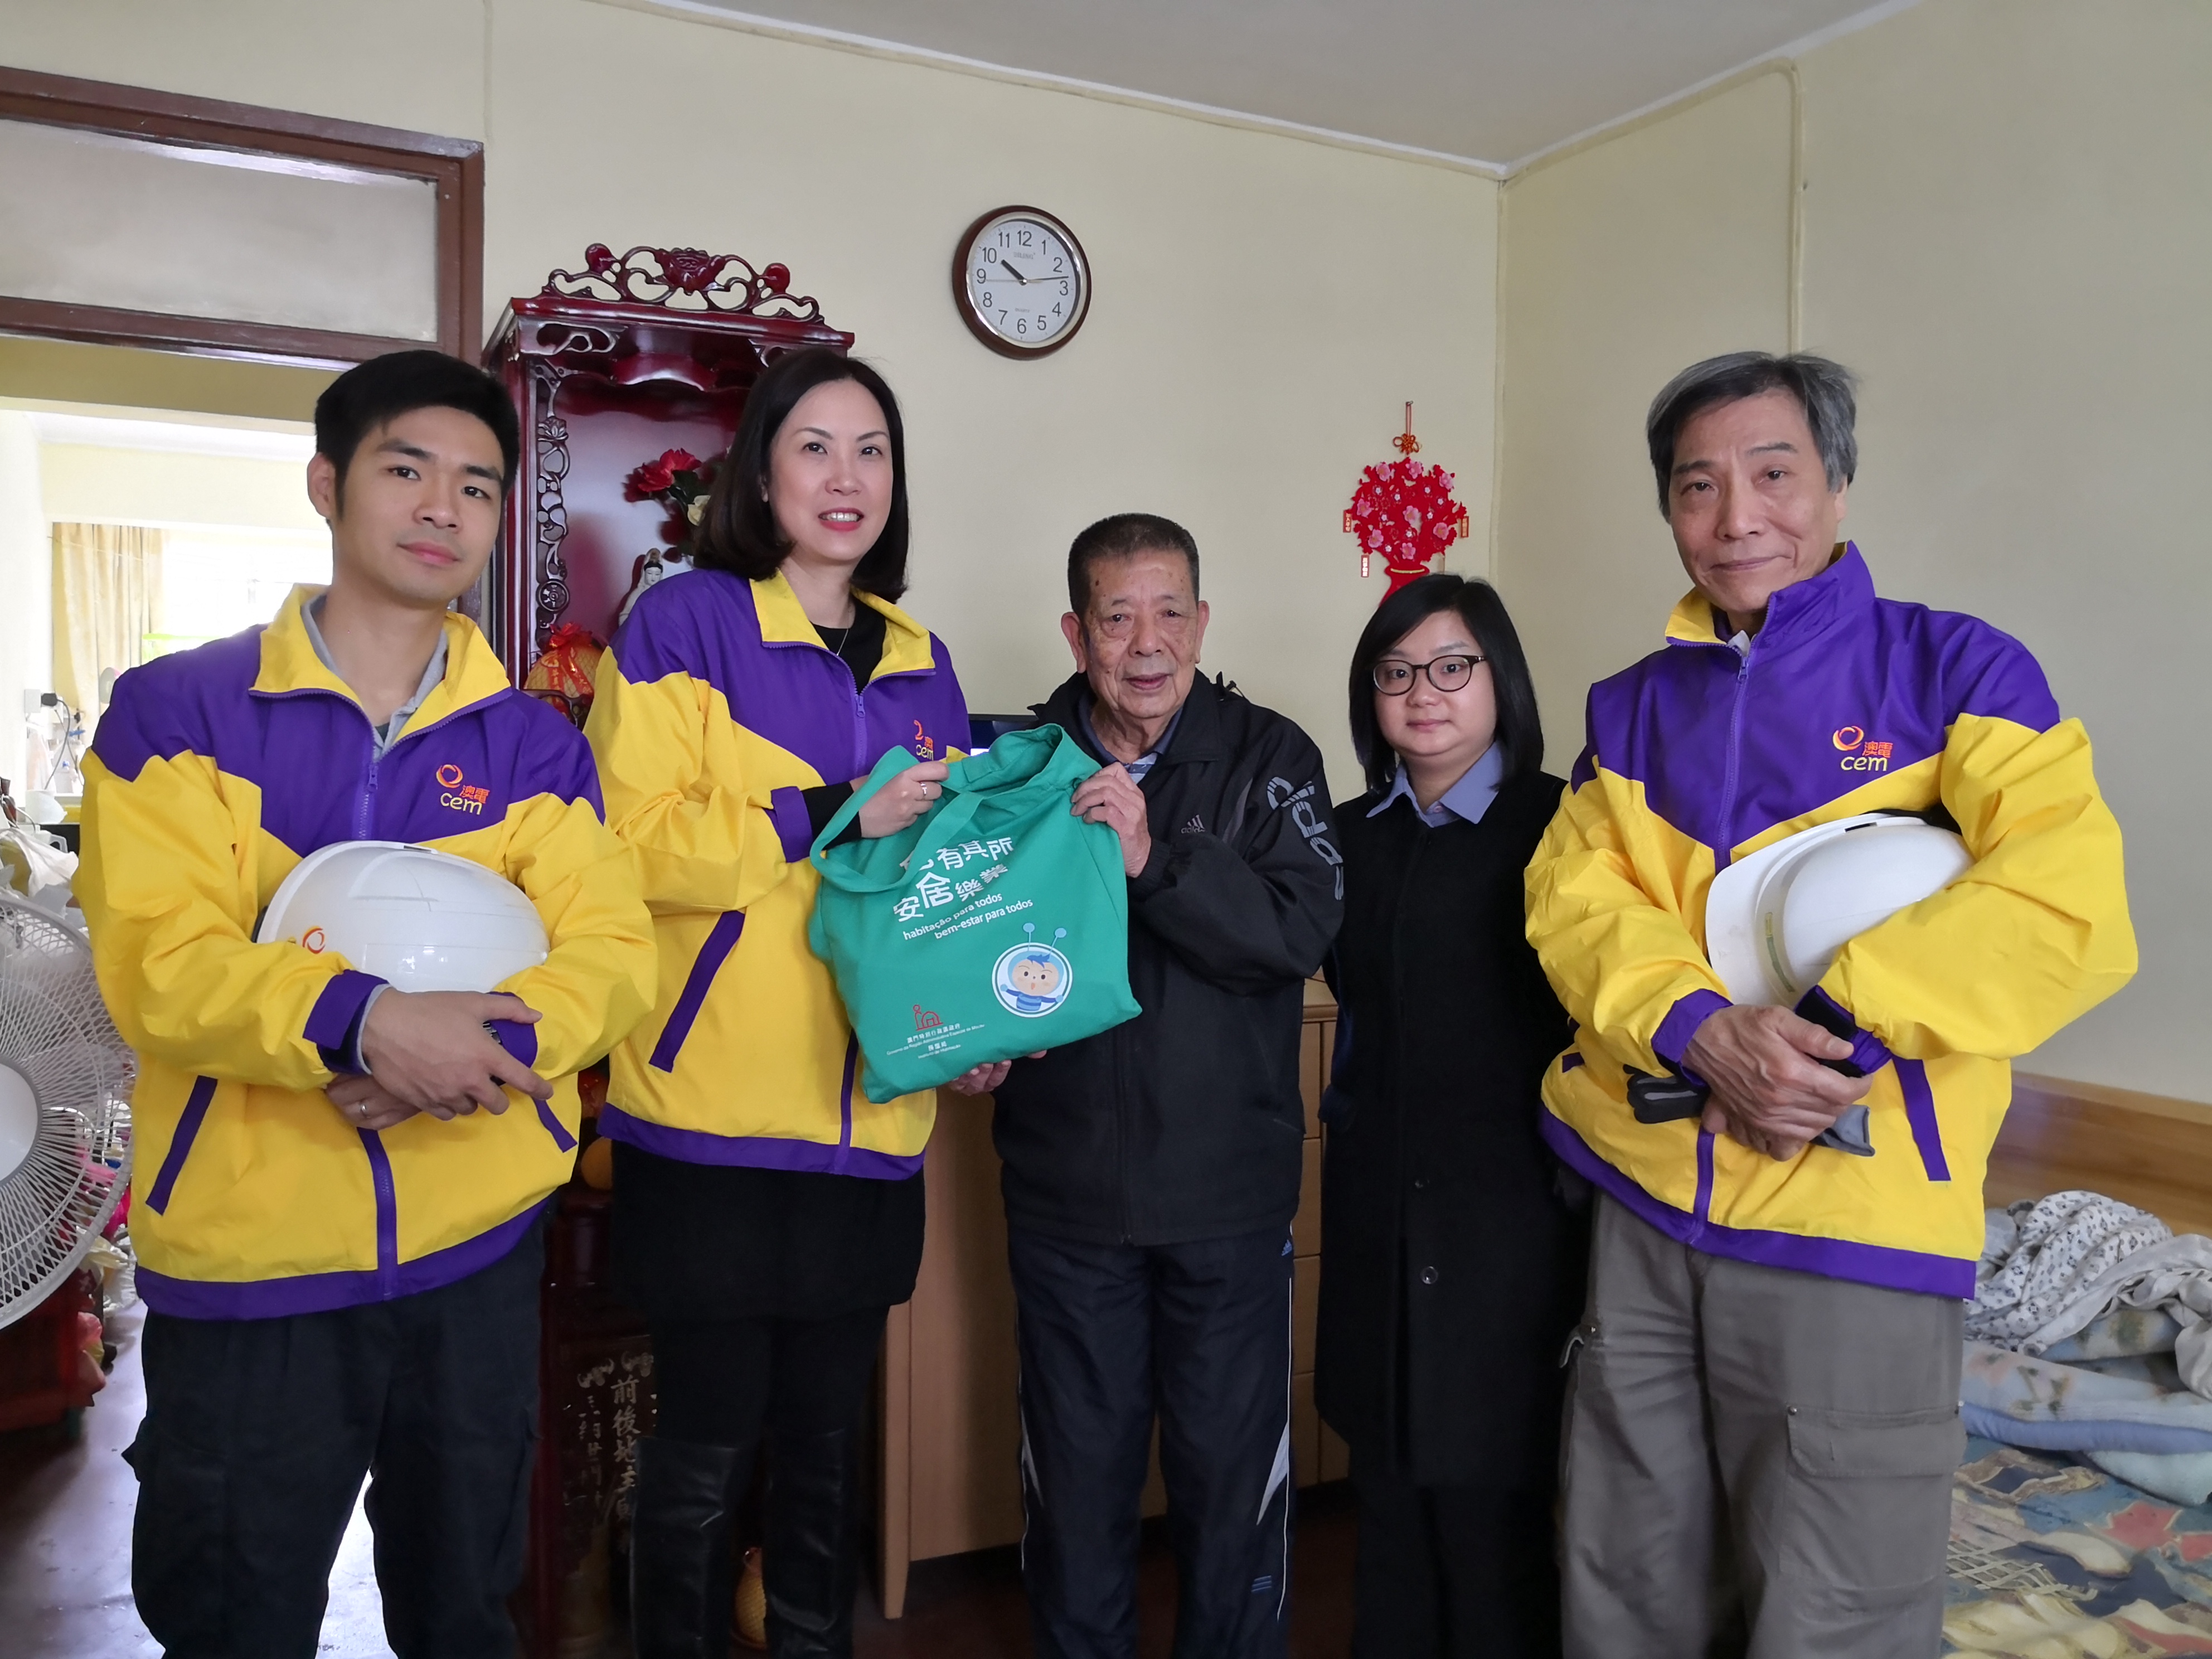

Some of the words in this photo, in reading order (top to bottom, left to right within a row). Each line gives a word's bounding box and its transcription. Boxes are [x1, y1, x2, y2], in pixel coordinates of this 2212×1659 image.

[998, 231, 1010, 248] 11
[1017, 230, 1032, 247] 12
[1041, 239, 1046, 255] 1
[982, 246, 997, 264] 10
[1052, 256, 1063, 273] 2
[976, 268, 986, 284] 9
[1059, 280, 1069, 296] 3
[982, 292, 992, 308] 8
[998, 309, 1008, 326] 7
[1051, 302, 1062, 317] 4
[1017, 318, 1027, 334] 6
[1037, 315, 1046, 331] 5
[916, 744, 934, 761] cem
[1841, 756, 1888, 772] cem
[440, 793, 482, 815] cem
[903, 917, 952, 940] habitação
[953, 904, 974, 920] para
[974, 893, 1003, 908] todos
[934, 914, 983, 939] bem-estar
[984, 909, 1006, 923] para
[1006, 899, 1034, 914] todos
